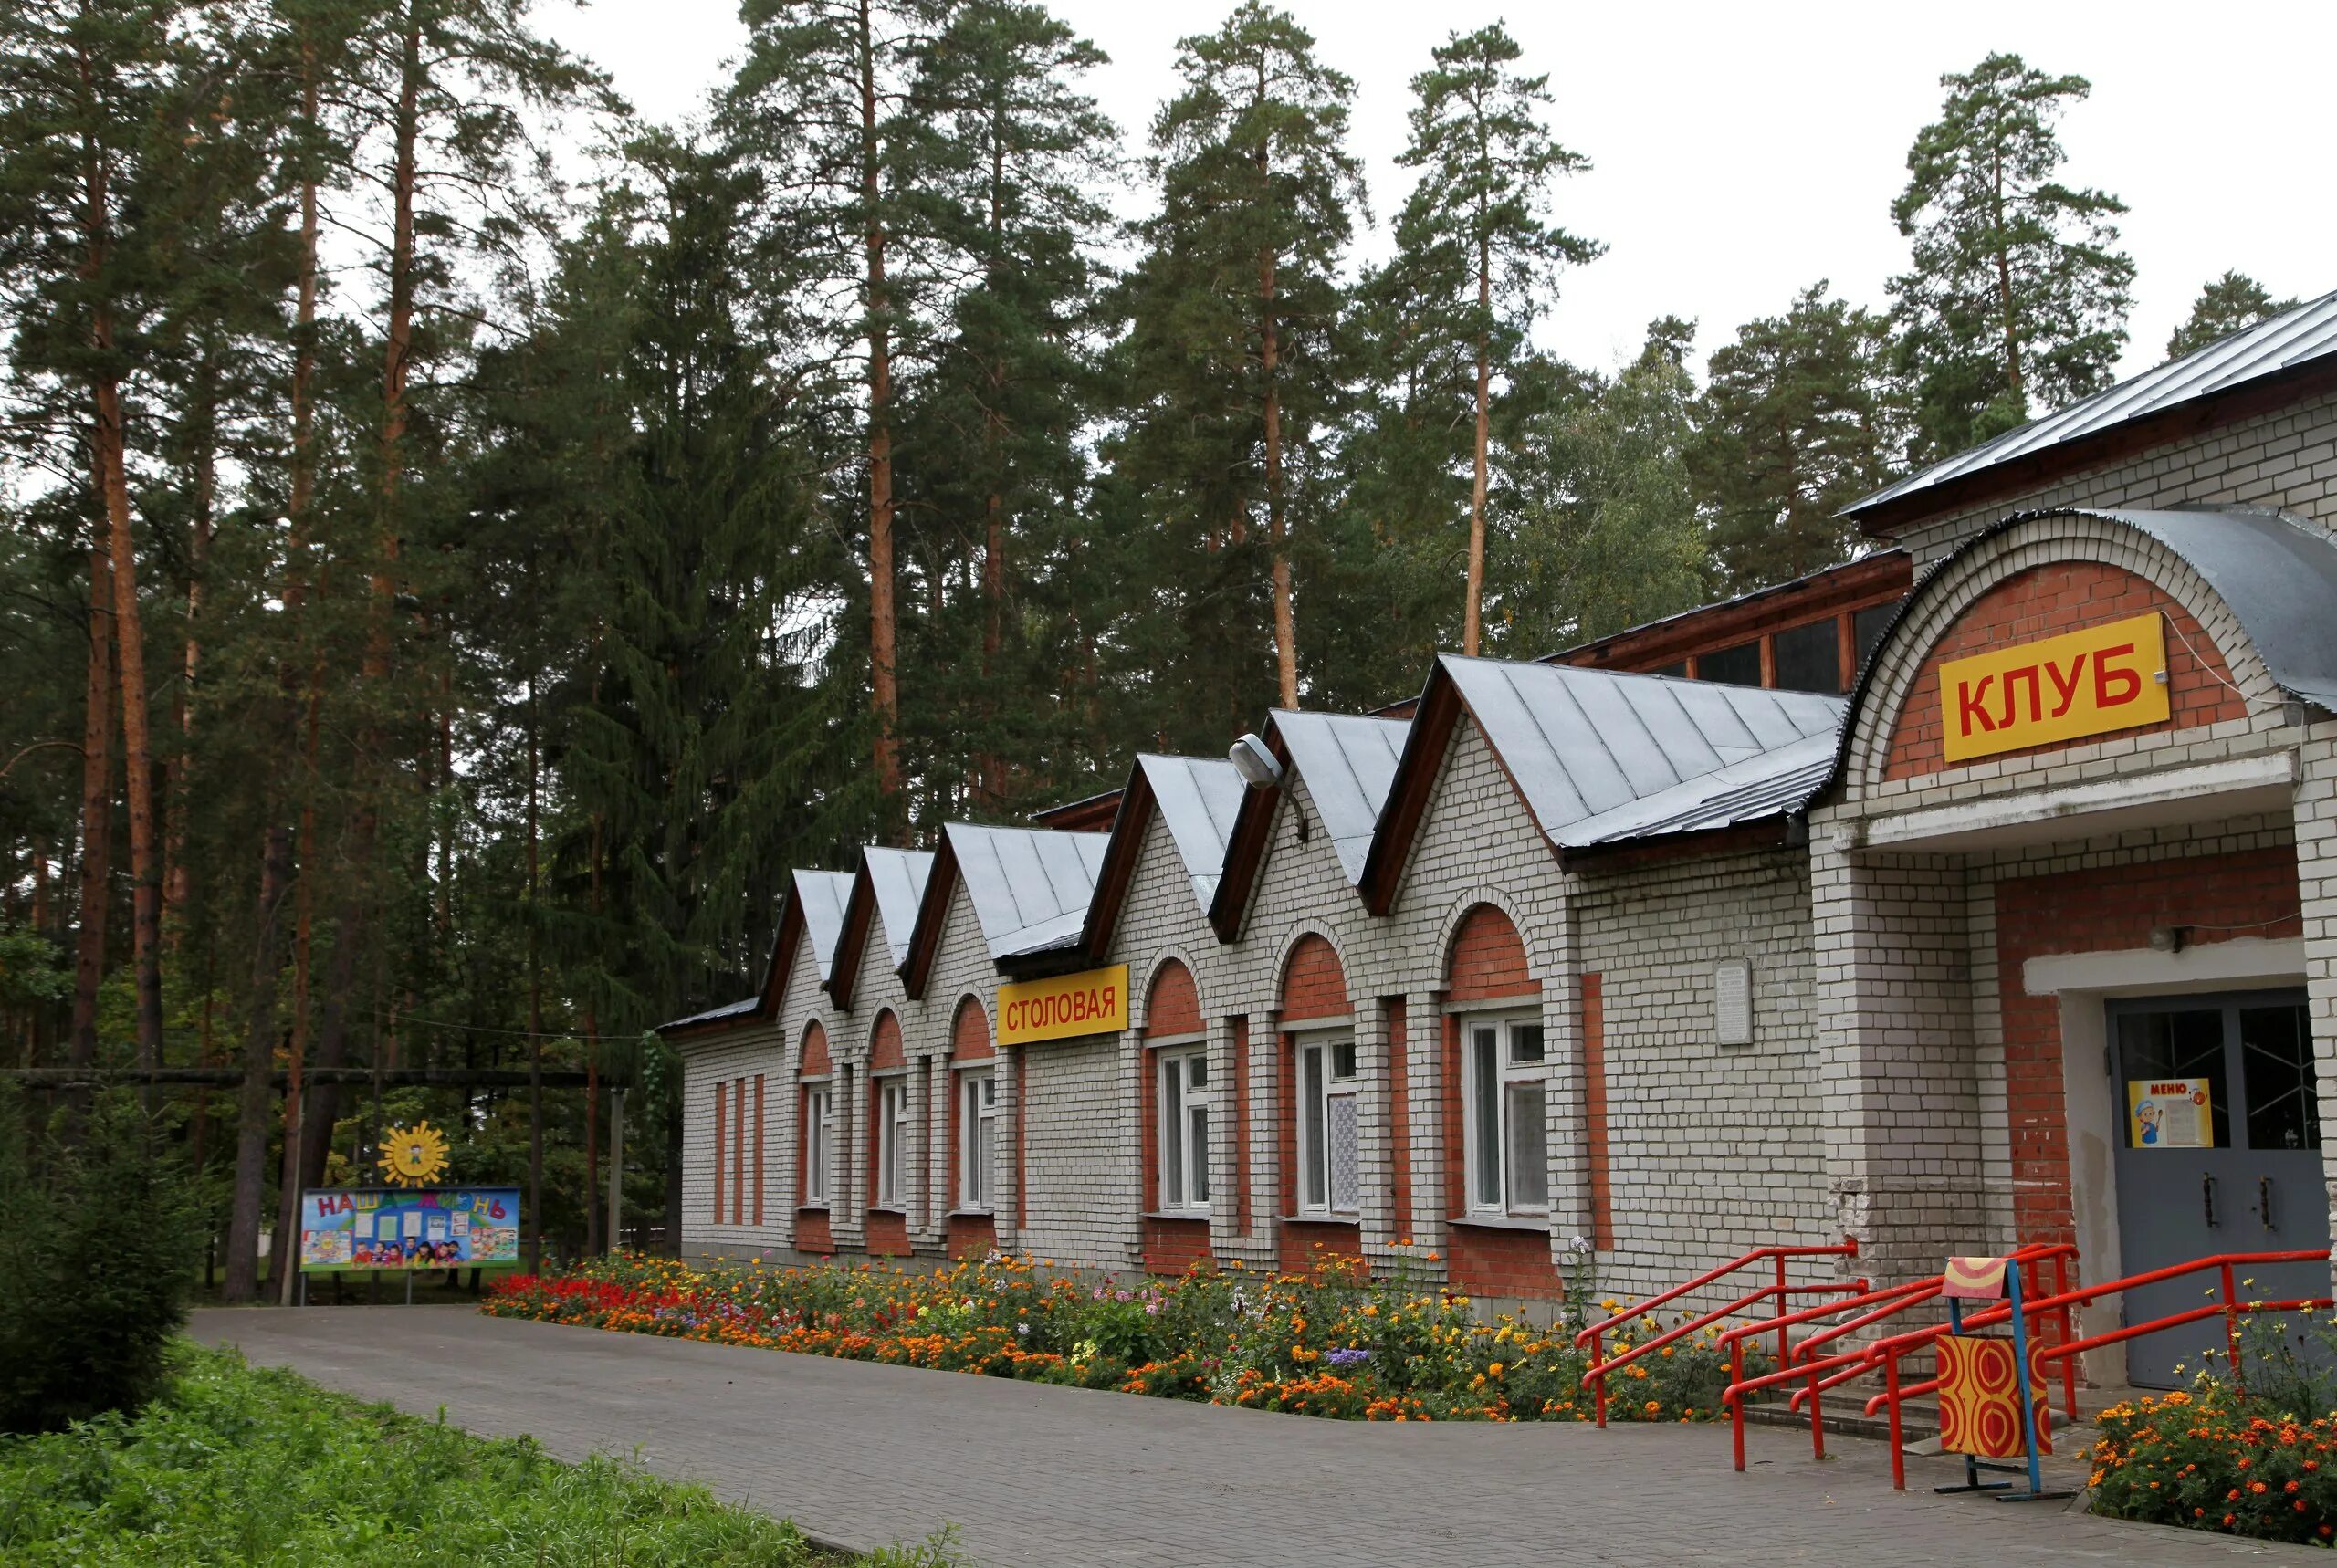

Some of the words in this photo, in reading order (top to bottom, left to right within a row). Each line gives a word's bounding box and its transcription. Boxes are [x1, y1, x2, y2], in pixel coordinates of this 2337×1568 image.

[1958, 643, 2142, 737] КЛУБ
[1007, 986, 1116, 1031] СТОЛОВАЯ
[2150, 1083, 2187, 1095] МЕНЮ
[318, 1191, 398, 1217] НАША
[417, 1190, 506, 1219] ЖИЗНЬ
